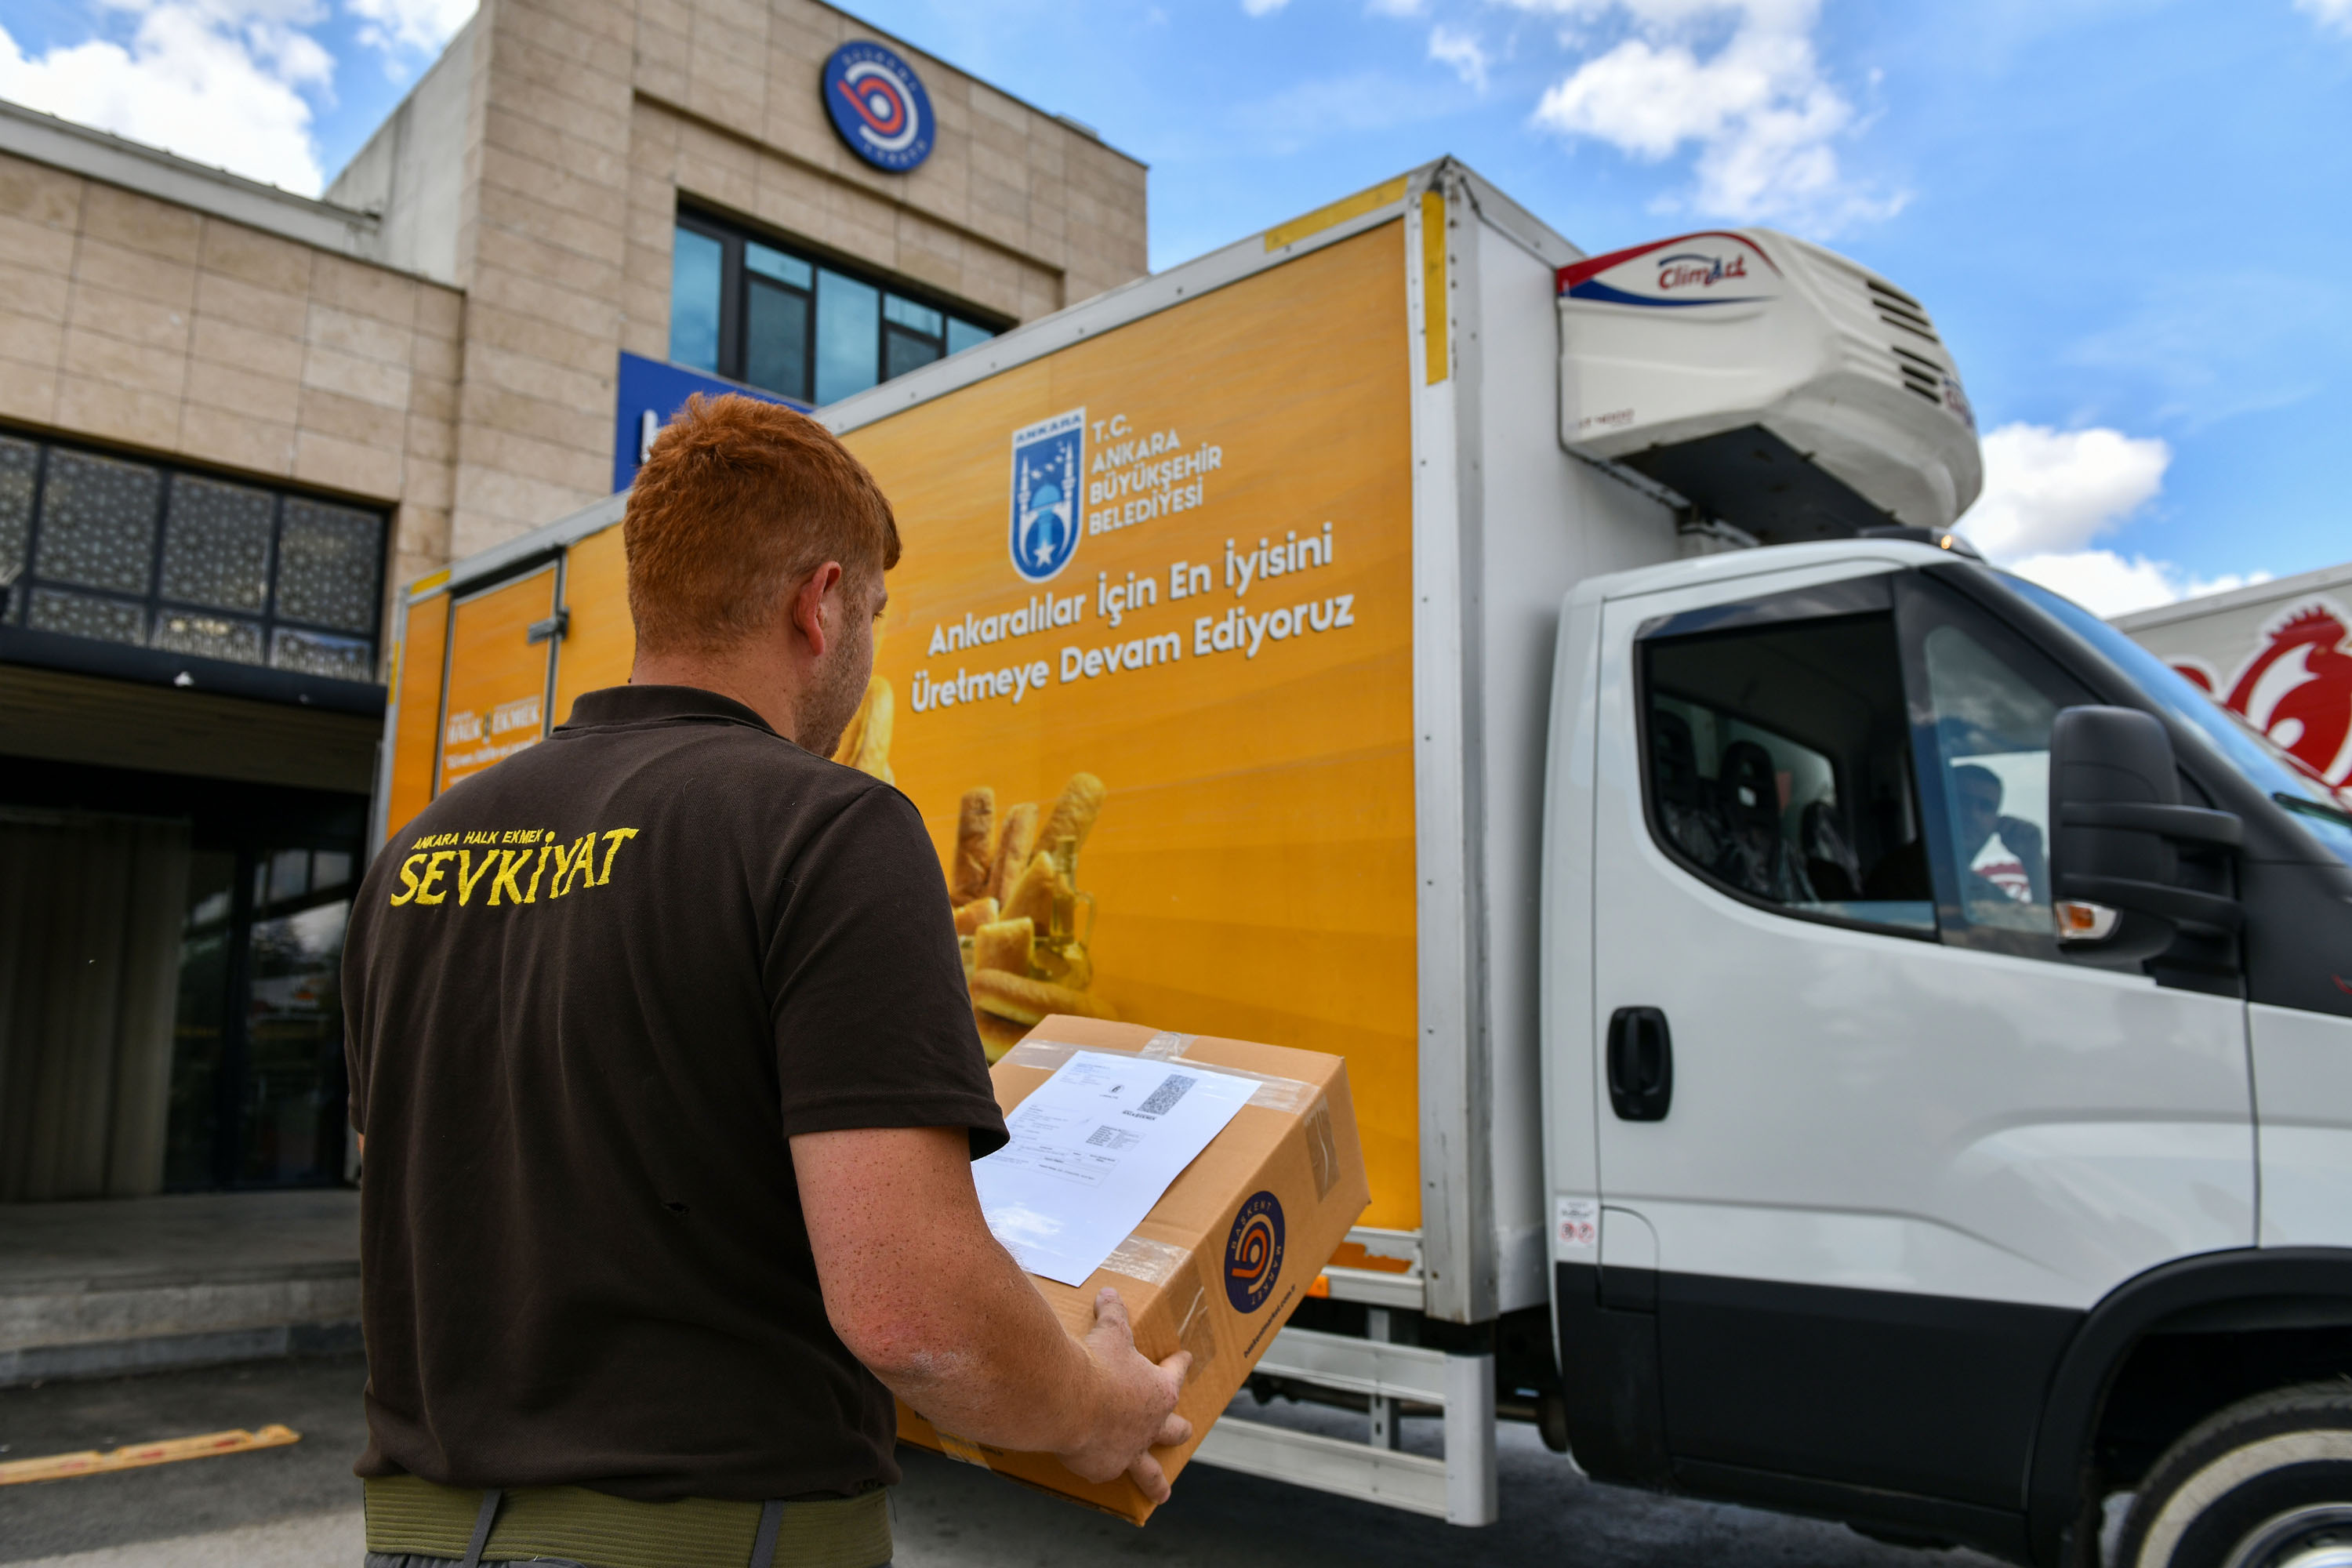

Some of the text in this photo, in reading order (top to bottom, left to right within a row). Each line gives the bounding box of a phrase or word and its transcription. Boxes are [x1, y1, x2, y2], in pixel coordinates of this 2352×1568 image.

[1091, 414, 1132, 443] T.C.
[1091, 428, 1181, 474] ANKARA
[1089, 442, 1222, 506] BÜYÜKŞEHİR
[1089, 476, 1203, 535] BELEDİYESİ
[927, 522, 1333, 657] Ankaralılar İçin En İyisini
[912, 594, 1355, 713] Üretmeye Devam Ediyoruz
[390, 827, 640, 907] SEVKİYAT
[412, 829, 544, 850] ANKARA HALK EKMEK
[1251, 1245, 1282, 1305] MARKET
